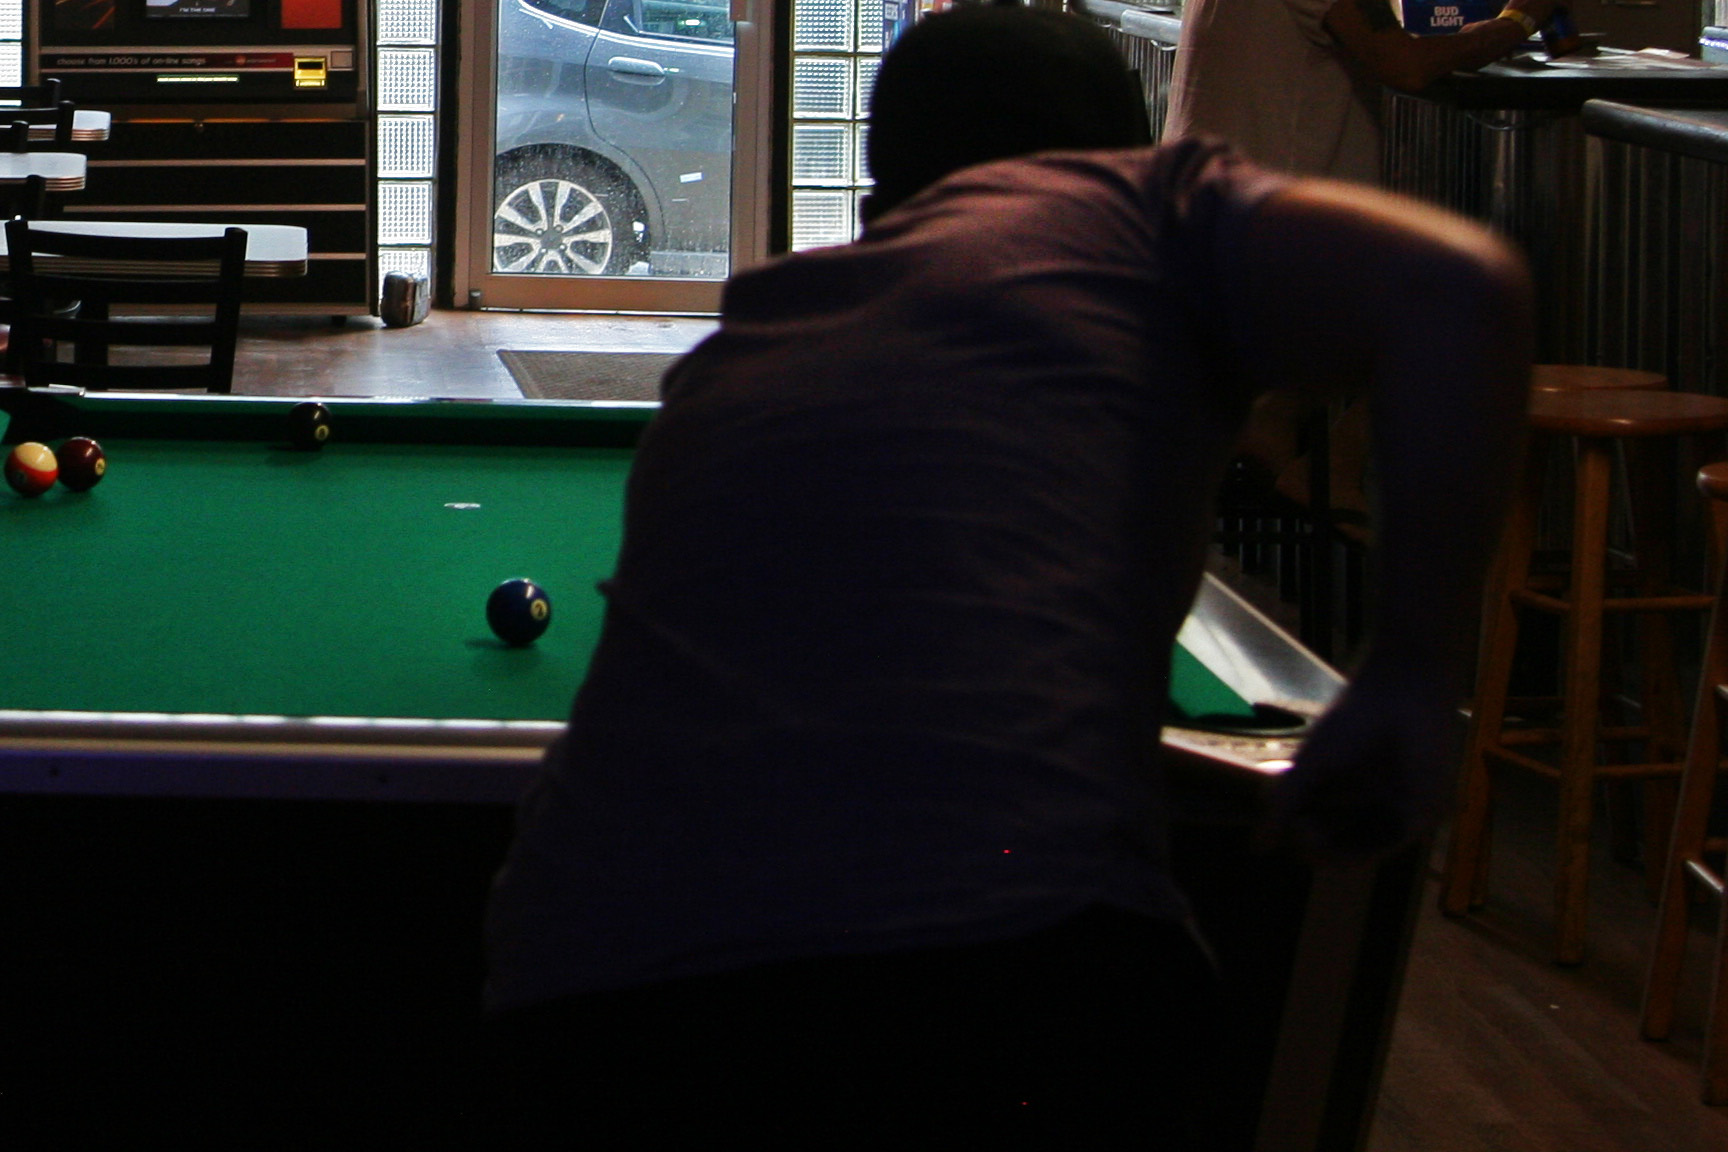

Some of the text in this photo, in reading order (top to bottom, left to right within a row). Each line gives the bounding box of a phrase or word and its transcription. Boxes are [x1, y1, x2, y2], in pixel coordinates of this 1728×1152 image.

[1434, 6, 1459, 16] BUD
[1430, 16, 1464, 27] LIGHT
[88, 57, 106, 65] from
[141, 57, 150, 65] of
[182, 58, 206, 66] songs
